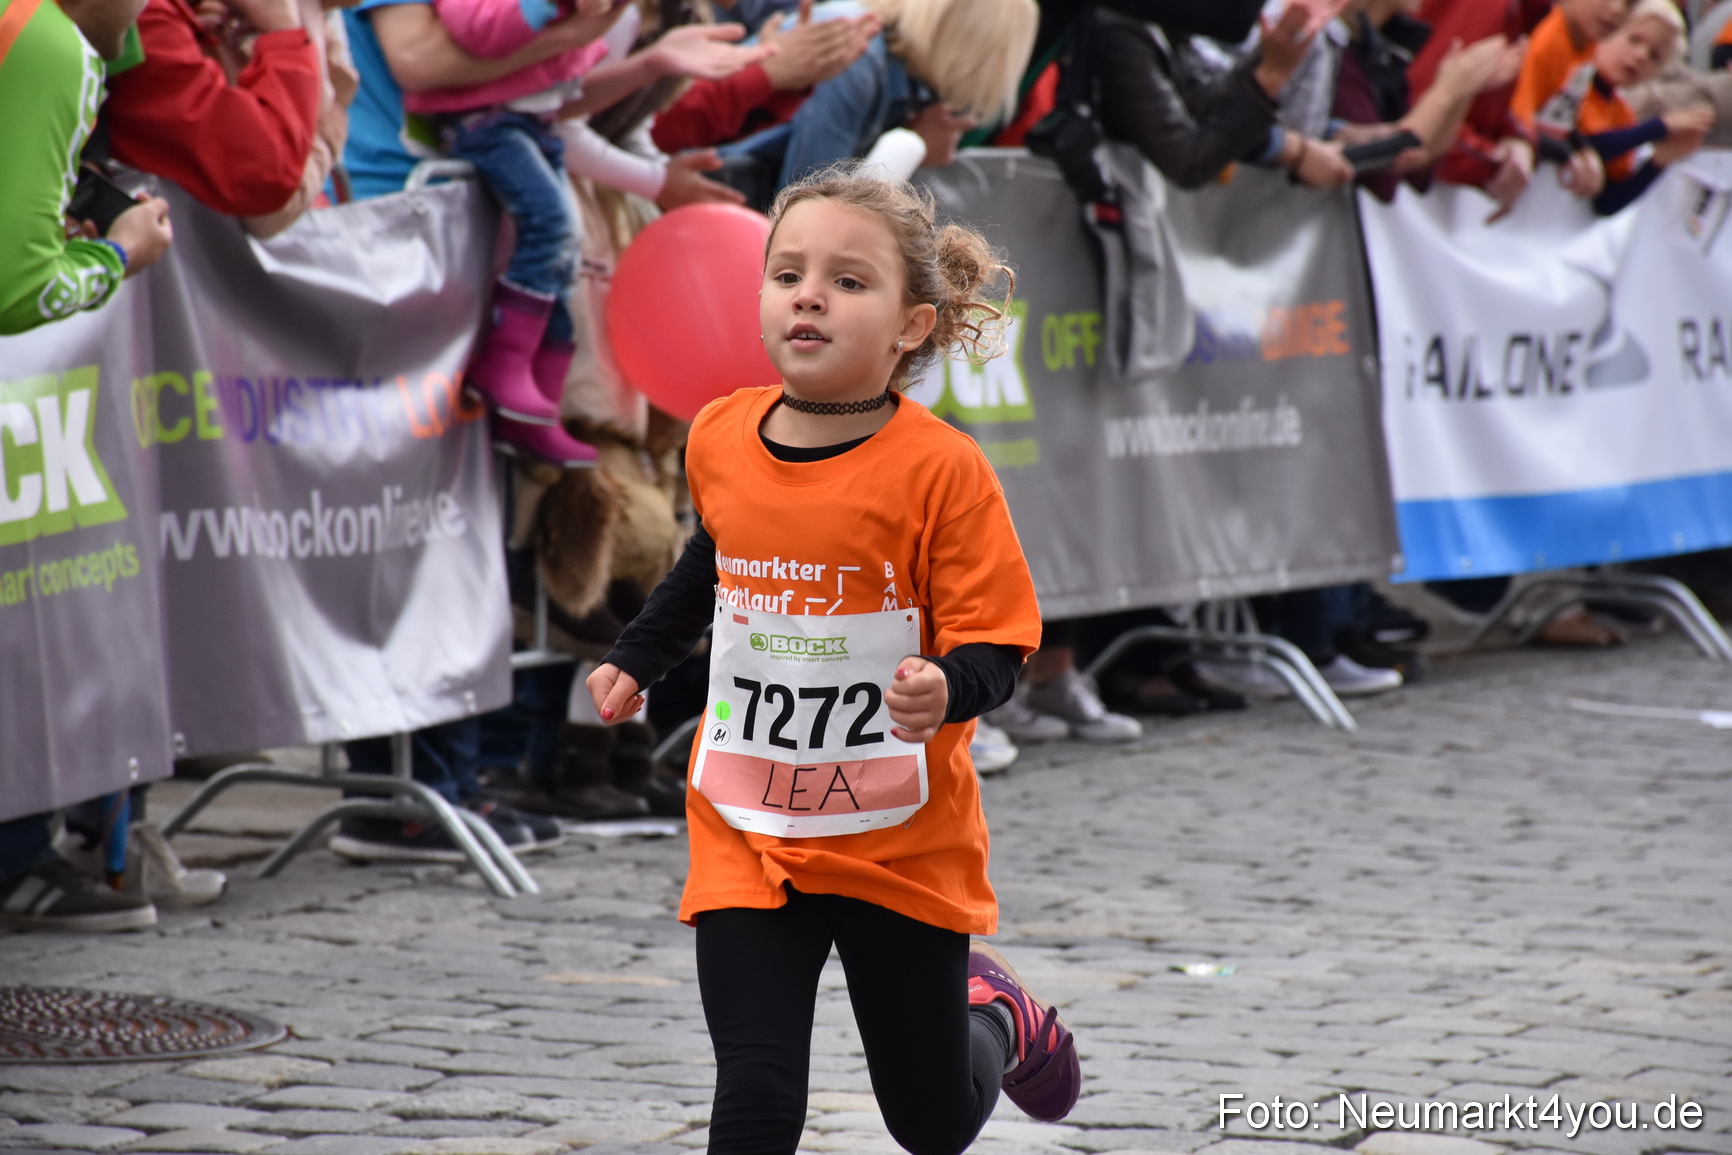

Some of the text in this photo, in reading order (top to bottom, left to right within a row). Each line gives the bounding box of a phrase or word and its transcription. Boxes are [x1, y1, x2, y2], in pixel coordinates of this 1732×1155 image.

[38, 540, 141, 593] concepts
[715, 550, 826, 582] Neumarkter
[769, 634, 849, 656] BOCK
[769, 654, 793, 662] inspired
[821, 655, 850, 663] concepts
[733, 676, 885, 750] 7272
[761, 763, 861, 811] LEA
